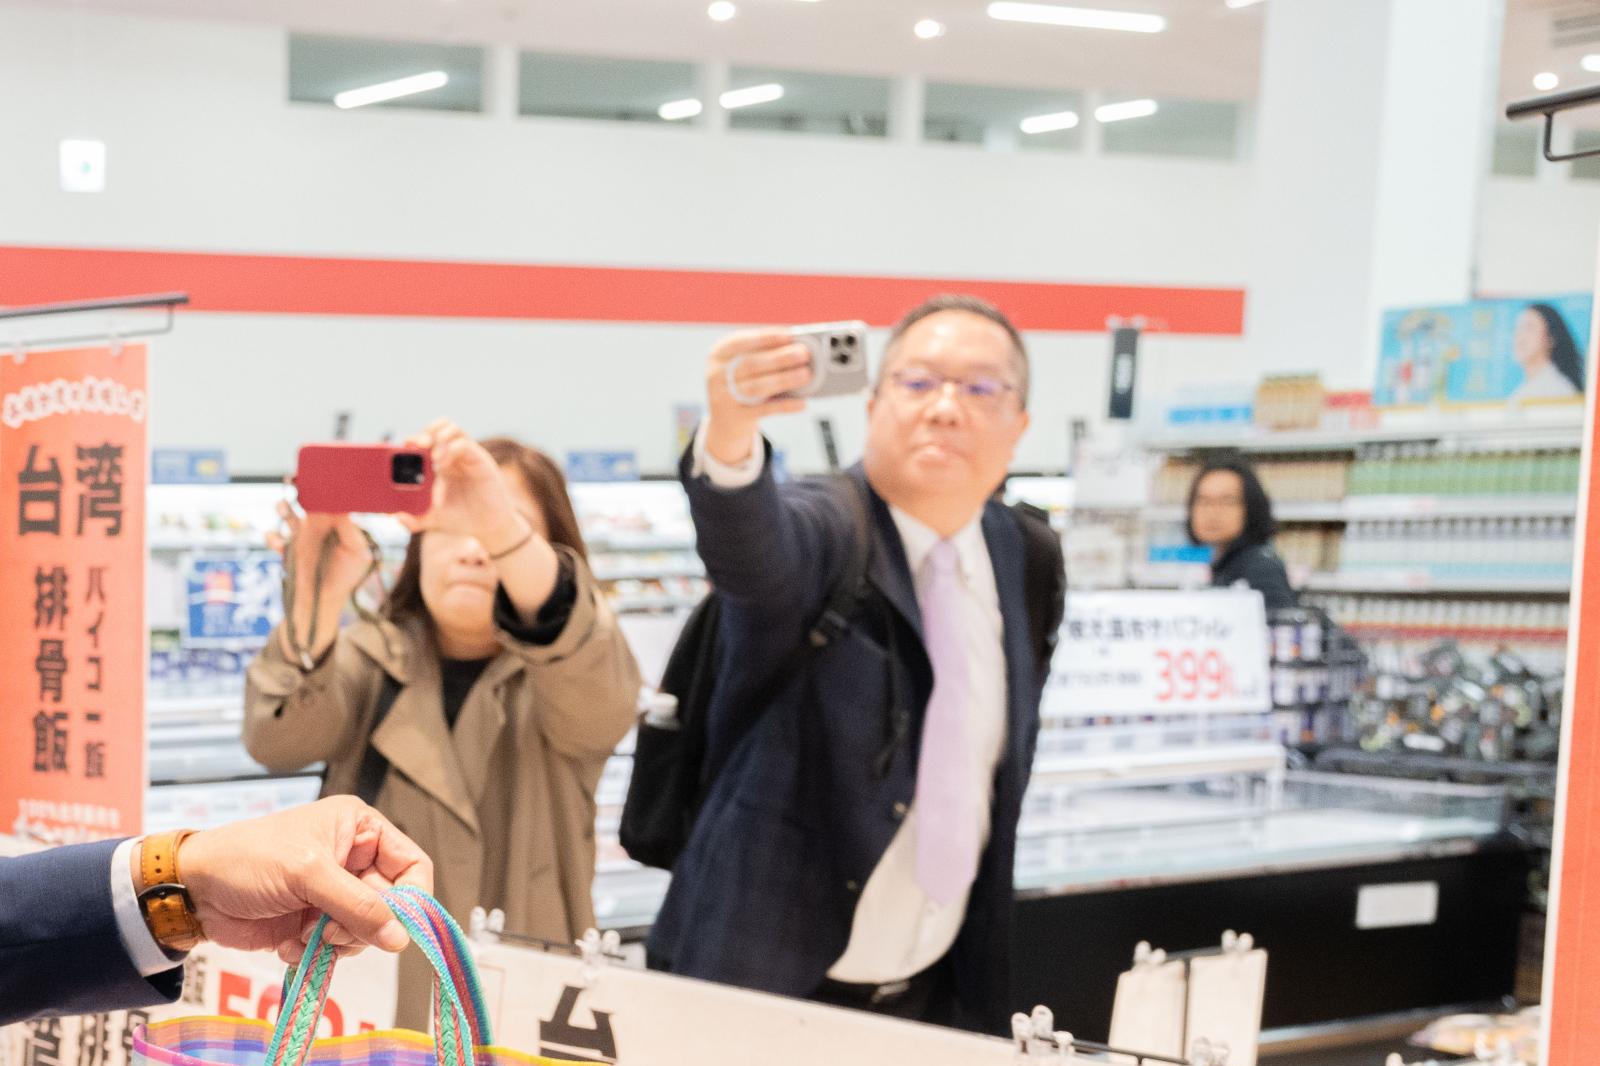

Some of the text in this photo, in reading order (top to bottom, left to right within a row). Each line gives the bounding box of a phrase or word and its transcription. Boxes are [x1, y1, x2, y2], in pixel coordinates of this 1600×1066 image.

[17, 443, 124, 536] 台湾
[32, 565, 69, 774] 排骨飯
[1155, 649, 1226, 701] 399
